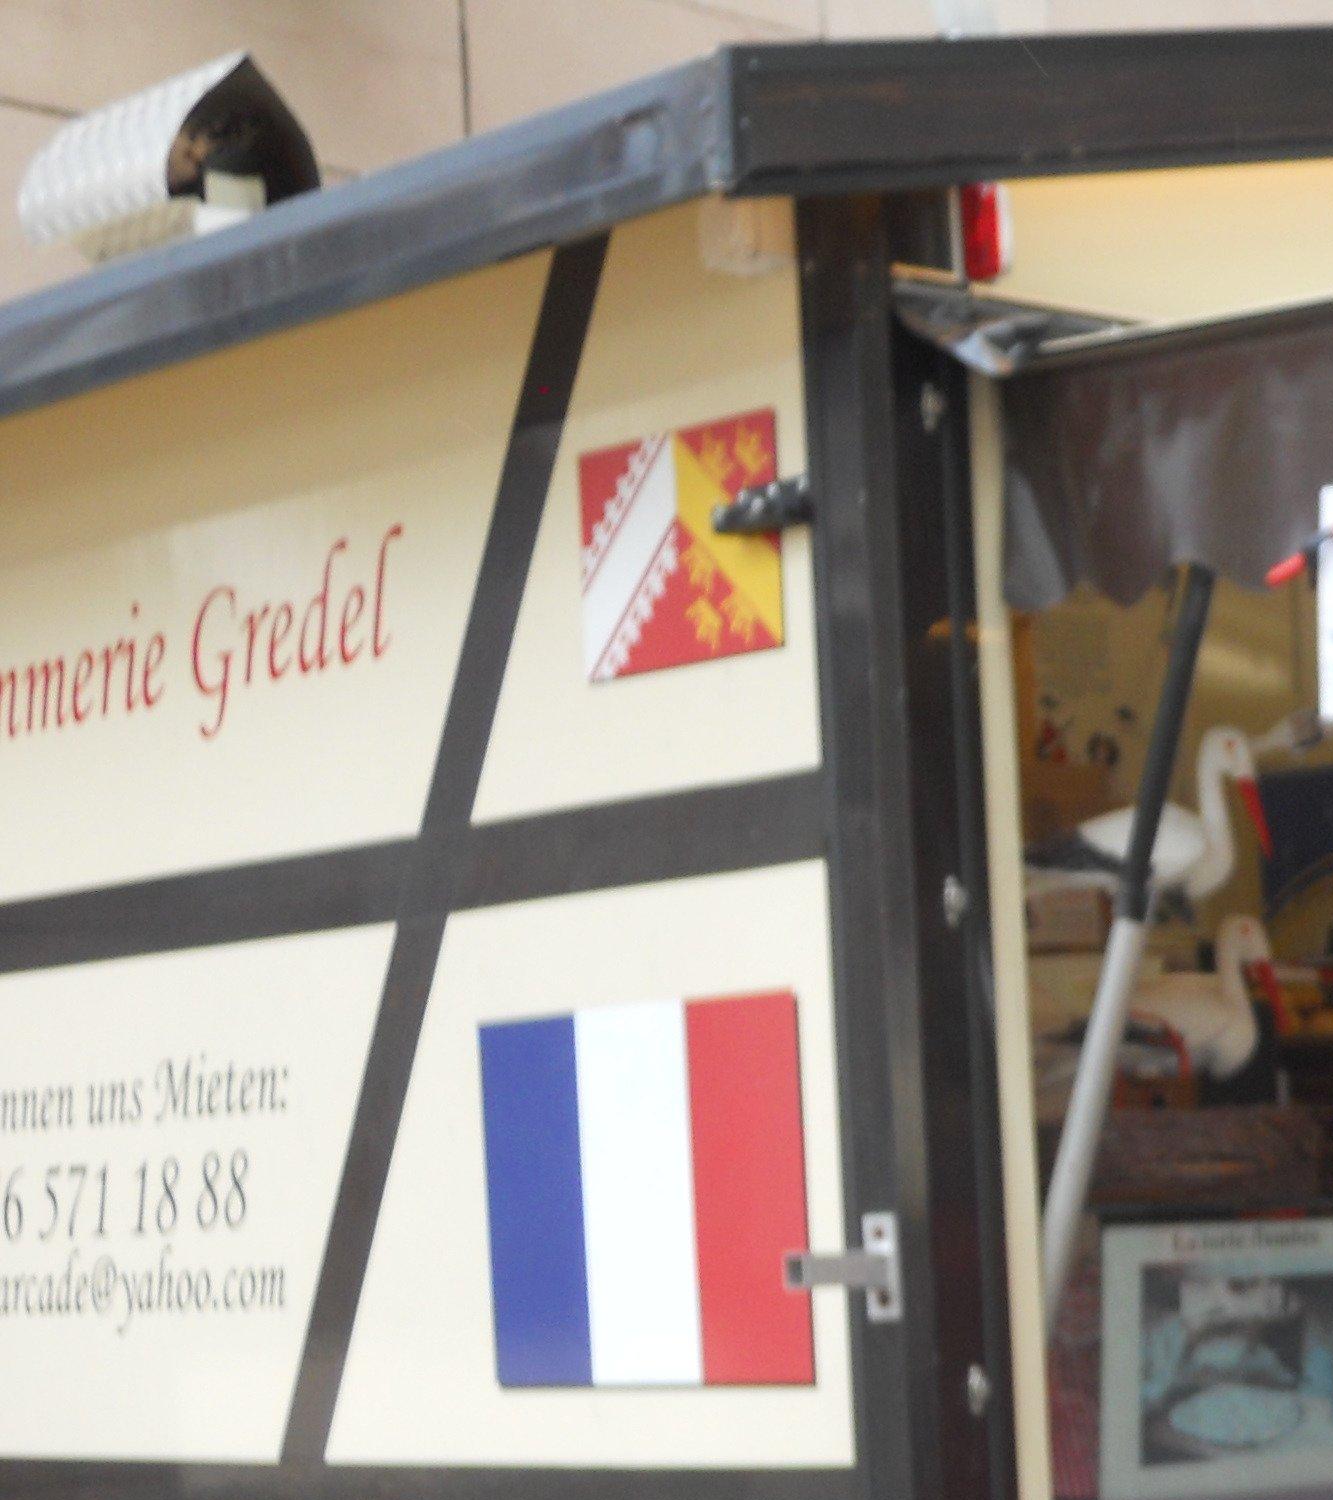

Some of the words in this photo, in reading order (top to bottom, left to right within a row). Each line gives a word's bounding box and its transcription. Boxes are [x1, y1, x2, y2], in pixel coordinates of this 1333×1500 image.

[191, 521, 404, 740] Gredel
[87, 1077, 144, 1126] uns
[153, 1050, 291, 1123] Mieten:
[38, 1160, 109, 1241] 571
[134, 1155, 180, 1236] 18
[195, 1147, 250, 1233] 88
